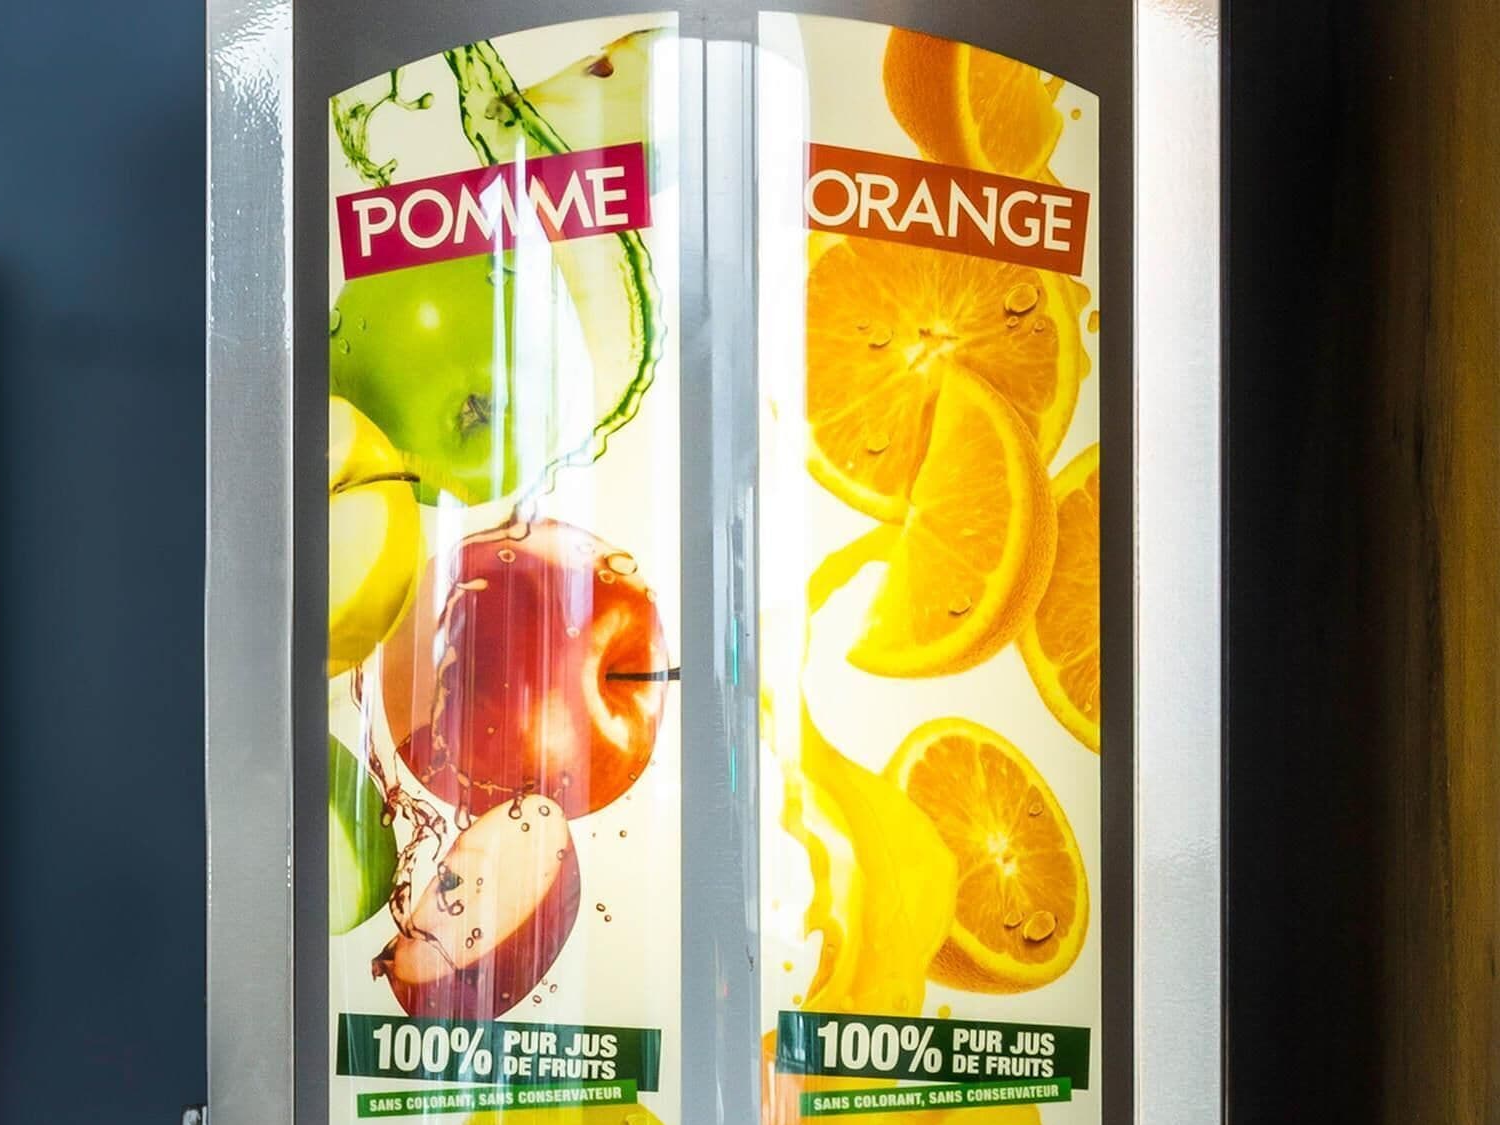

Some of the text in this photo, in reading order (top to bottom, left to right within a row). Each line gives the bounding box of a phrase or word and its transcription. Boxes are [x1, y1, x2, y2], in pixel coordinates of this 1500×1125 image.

[804, 169, 1073, 251] ORANGE
[373, 1023, 618, 1075] 100% PUR JUS
[817, 1021, 1056, 1074] 100% PUR JUS
[503, 1056, 617, 1080] DE FRUITS
[952, 1054, 1055, 1078] DE FRUITS
[369, 1098, 403, 1112] SANS
[478, 1091, 514, 1106] SANS
[518, 1086, 622, 1105] CONSERVATEUR
[813, 1084, 1059, 1111] SANS COLORANT, SANS CONSERVATEUR
